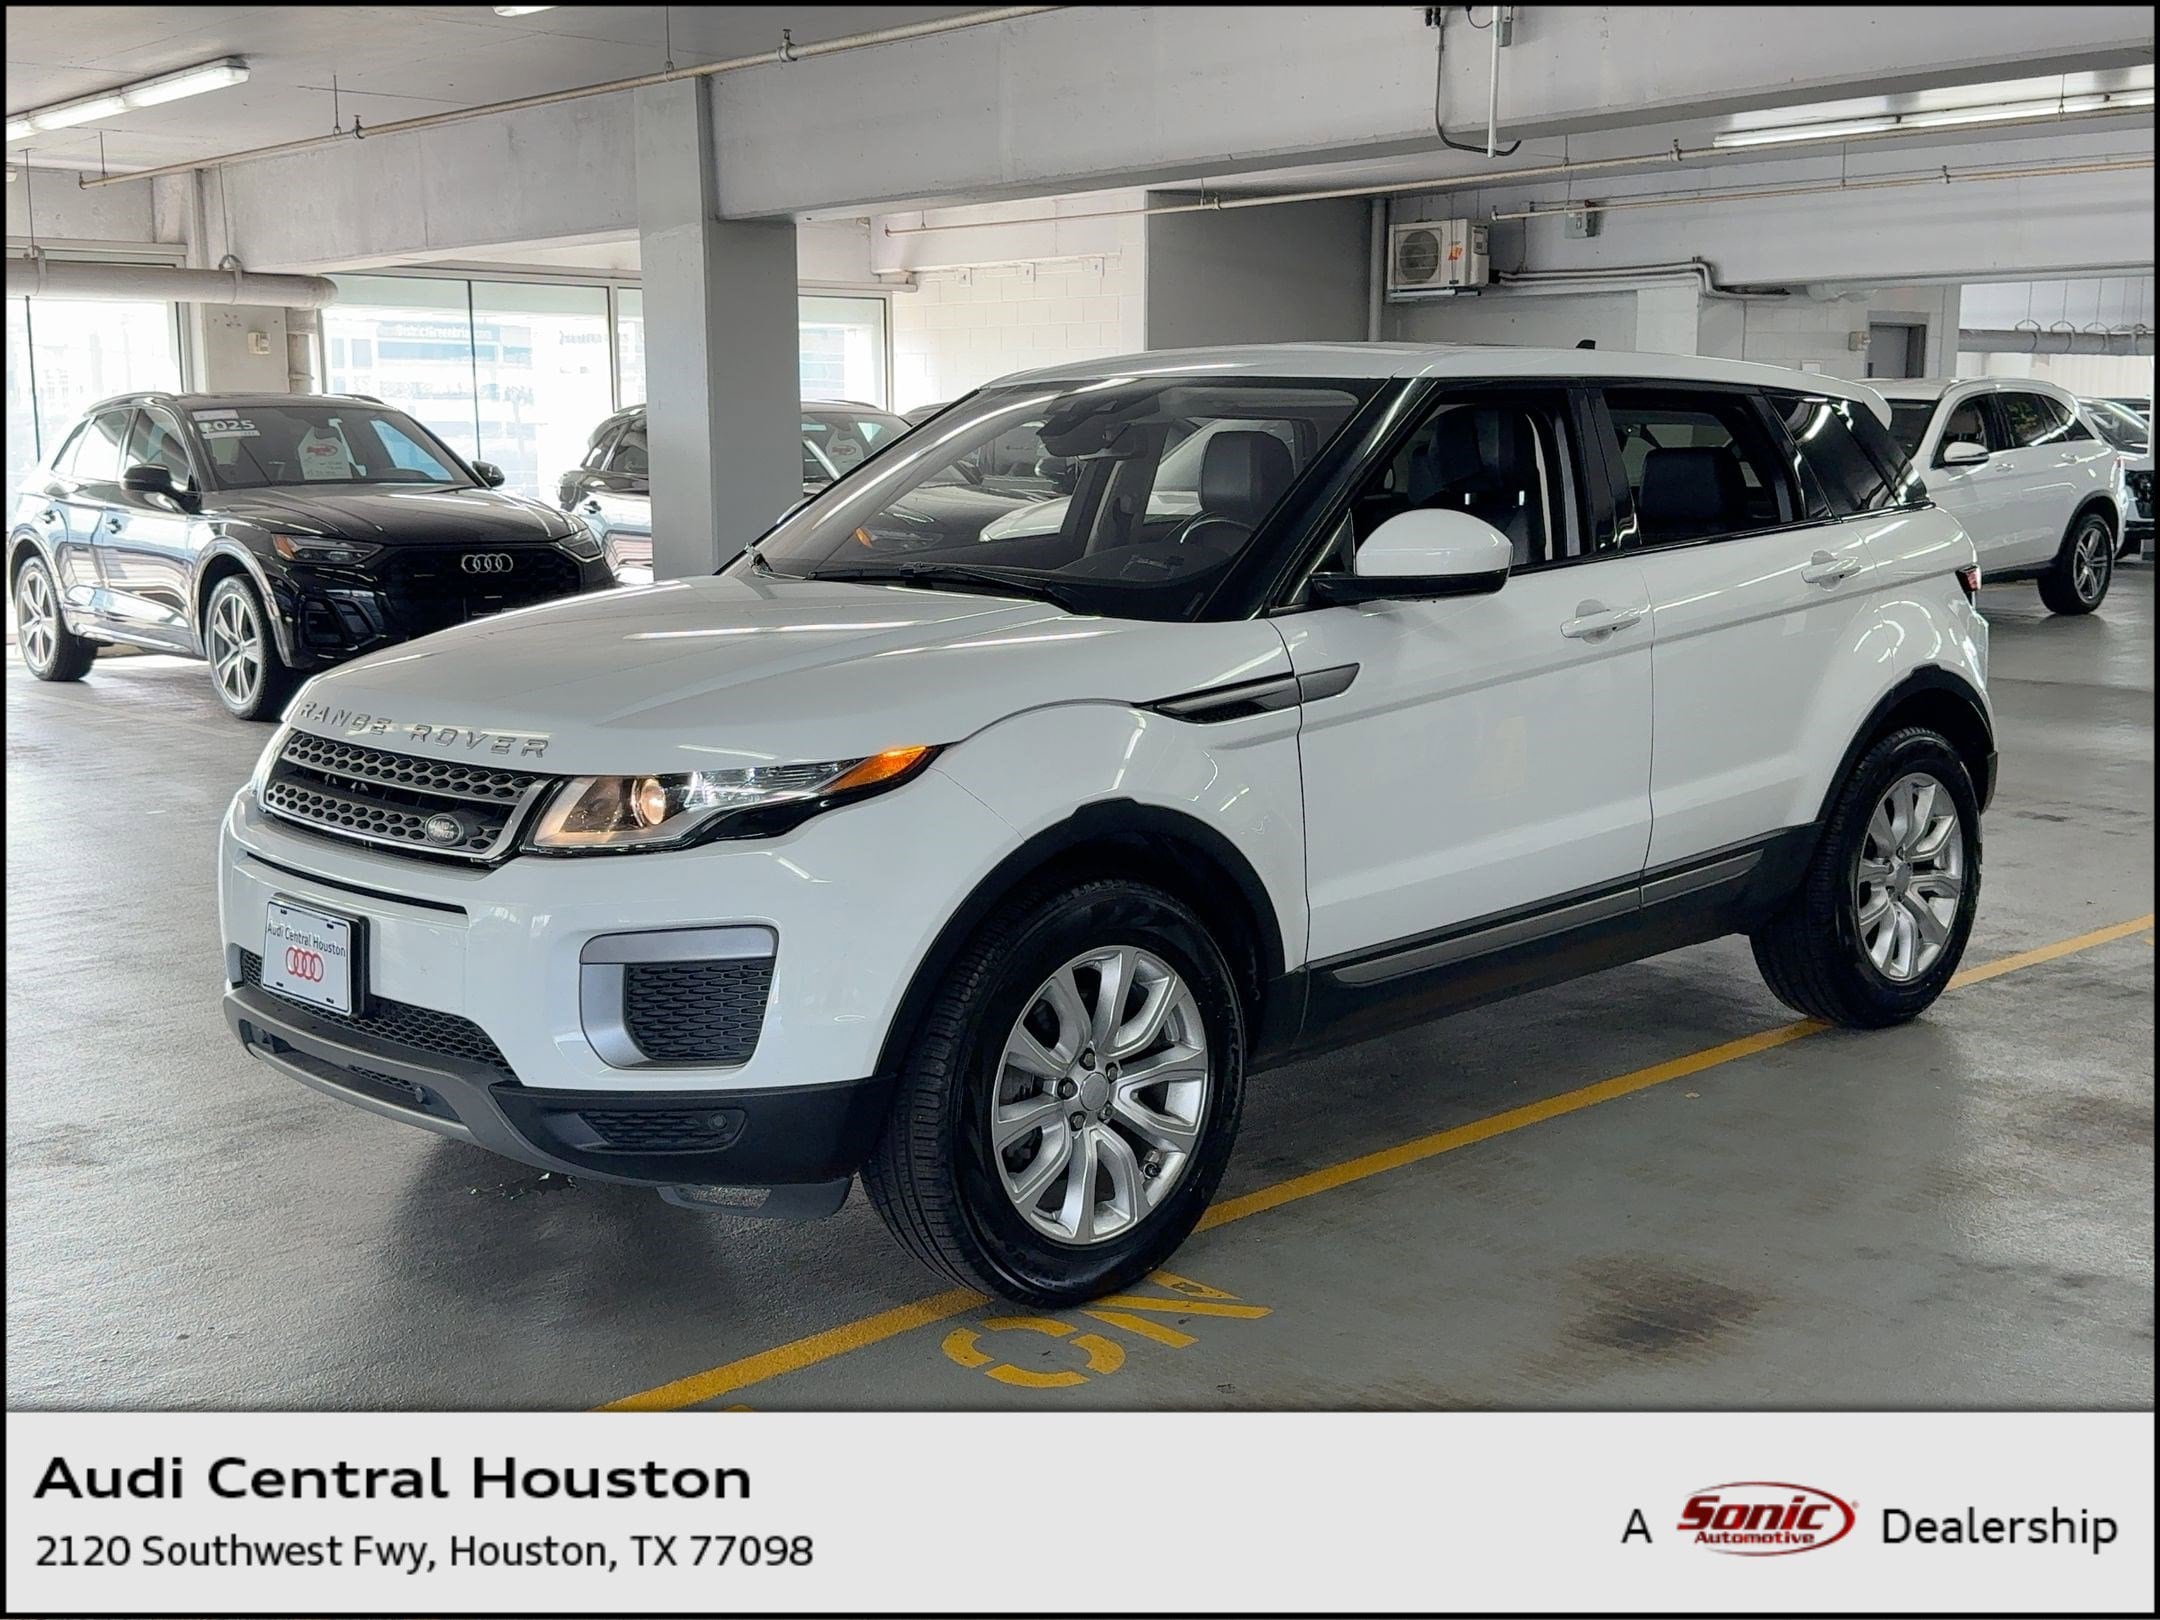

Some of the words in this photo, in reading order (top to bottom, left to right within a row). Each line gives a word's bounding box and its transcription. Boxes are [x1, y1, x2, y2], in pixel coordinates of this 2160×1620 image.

[300, 701, 392, 736] RANGE
[408, 723, 549, 758] ROVER
[267, 922, 284, 937] Audi
[285, 927, 311, 947] Central
[313, 936, 346, 957] Houston
